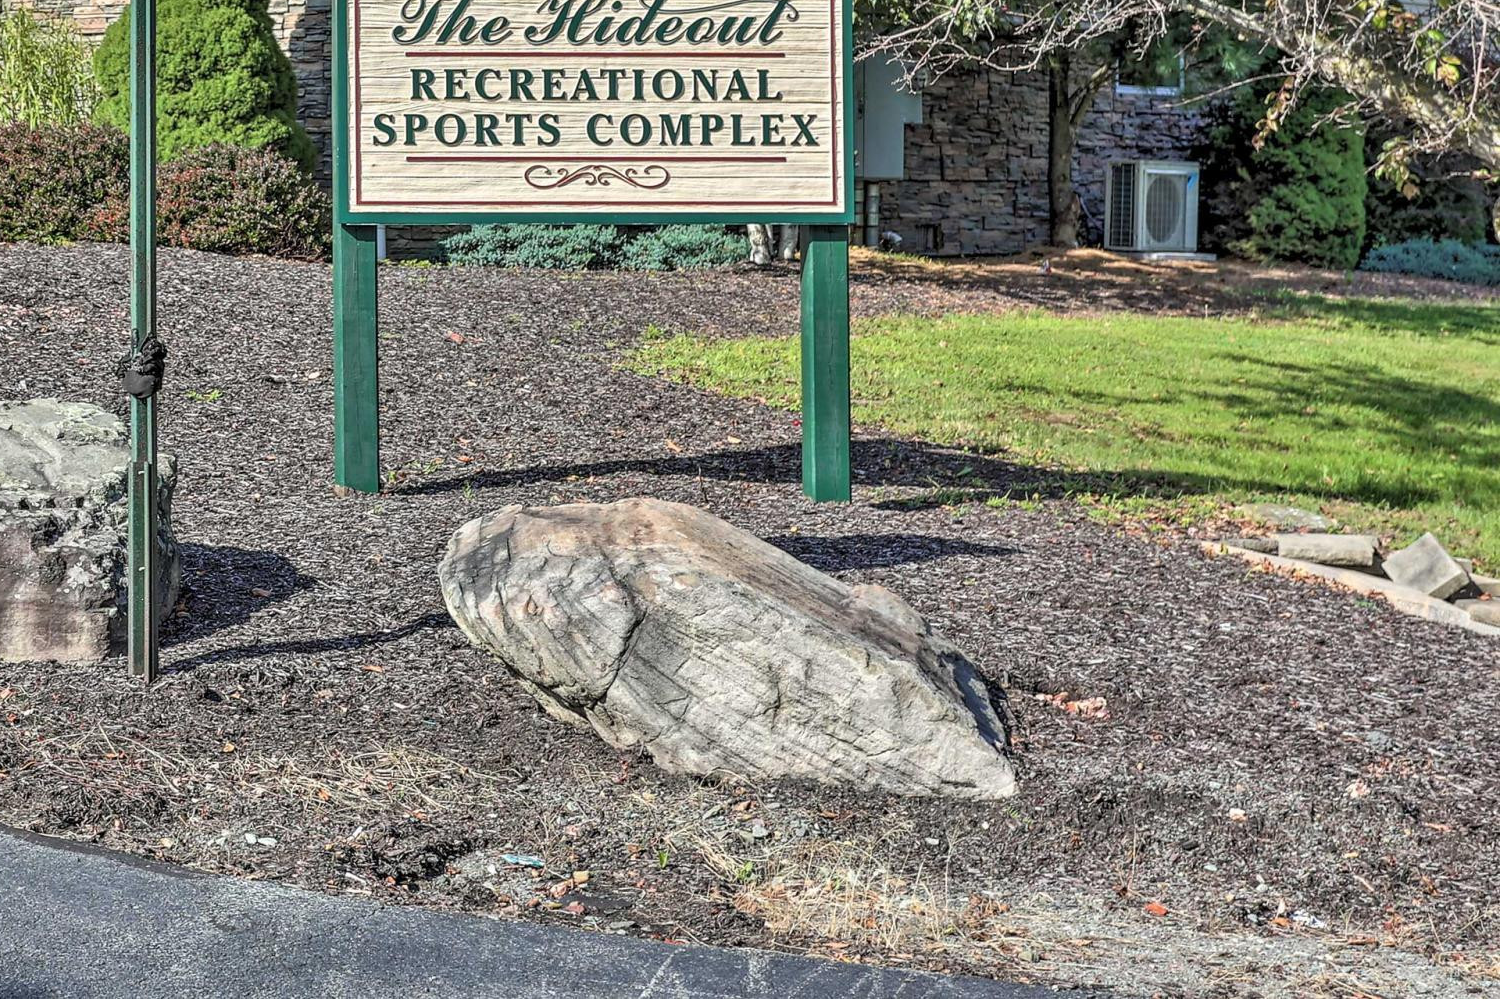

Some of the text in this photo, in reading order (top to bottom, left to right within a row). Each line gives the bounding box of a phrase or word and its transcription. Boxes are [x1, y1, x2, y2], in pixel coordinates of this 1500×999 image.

[410, 68, 784, 102] RECREATIONAL
[372, 113, 820, 147] SPORTS COMPLEX
